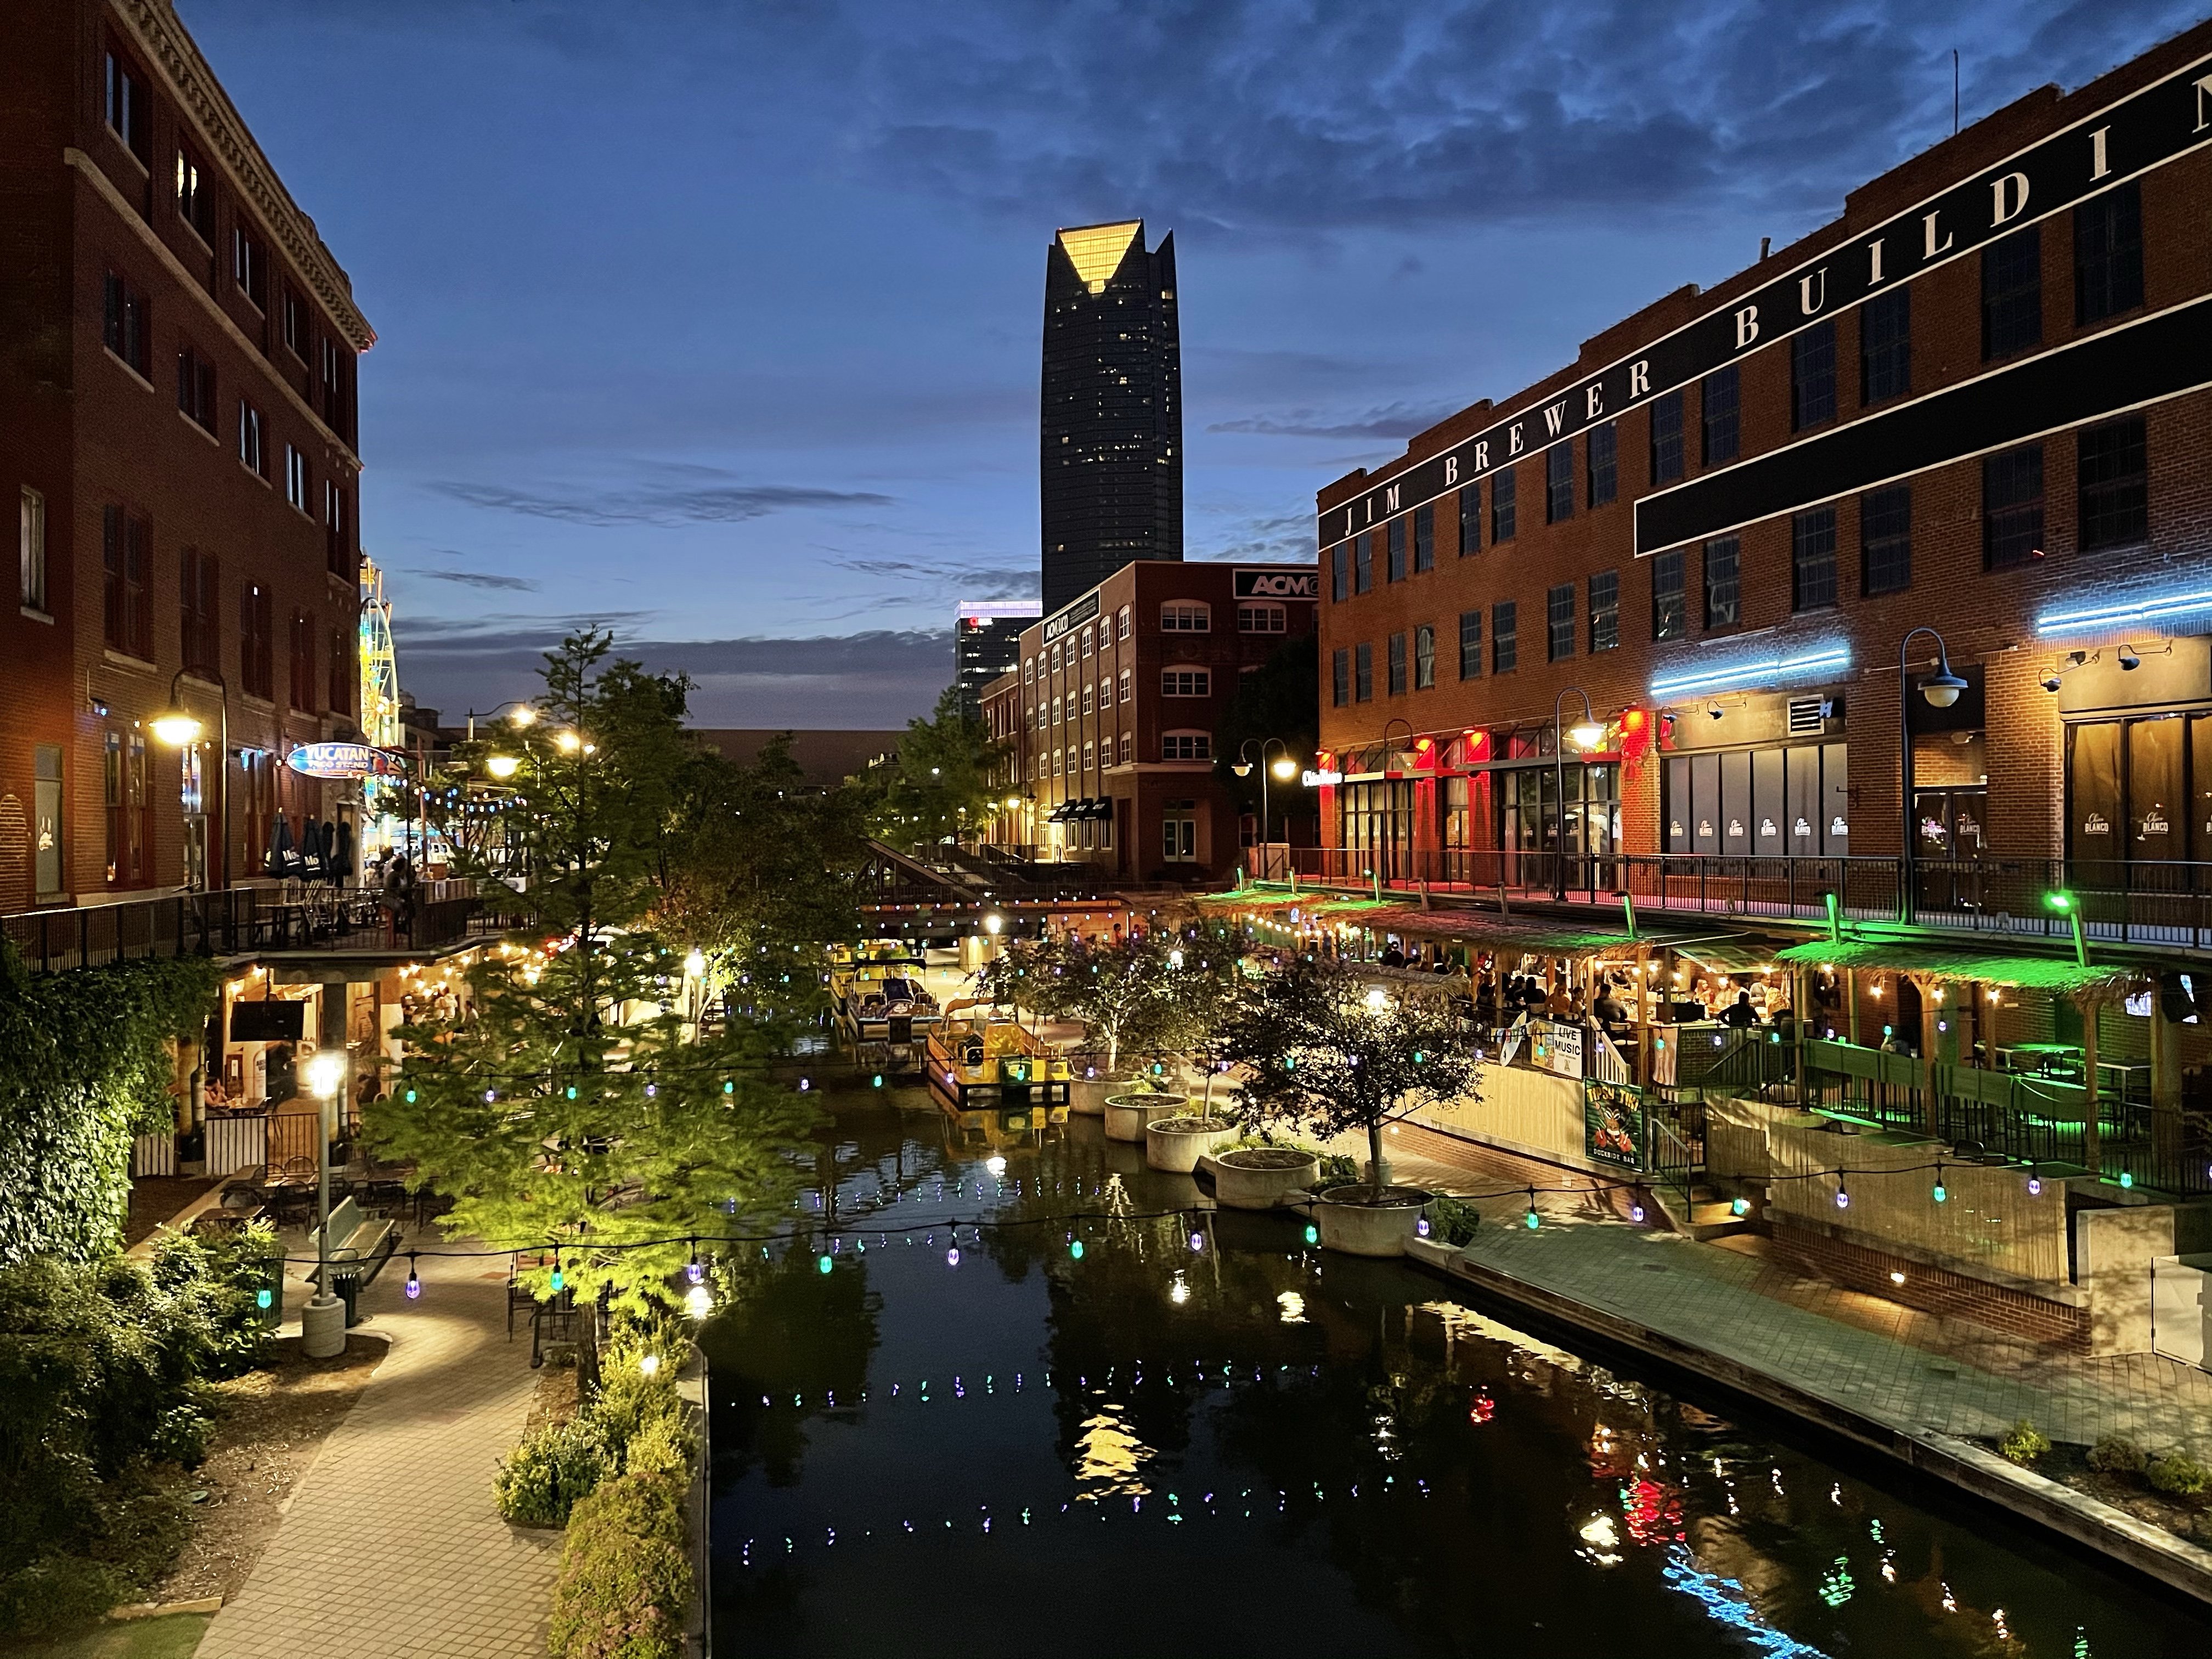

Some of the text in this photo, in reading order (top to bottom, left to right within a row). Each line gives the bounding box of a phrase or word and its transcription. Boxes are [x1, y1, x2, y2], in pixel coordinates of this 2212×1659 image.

[1345, 483, 1401, 537] JIM
[1444, 360, 1651, 487] BREWER
[306, 747, 369, 761] YUCATAN
[2085, 823, 2109, 832] BLANCO
[2143, 822, 2168, 832] BLANCO
[1559, 1027, 1576, 1040] LIVE
[1555, 1040, 1580, 1056] MUSIC
[1587, 1086, 1639, 1112] TIPSY TIKI
[1593, 1148, 1634, 1164] DOCKSIDE BAR
